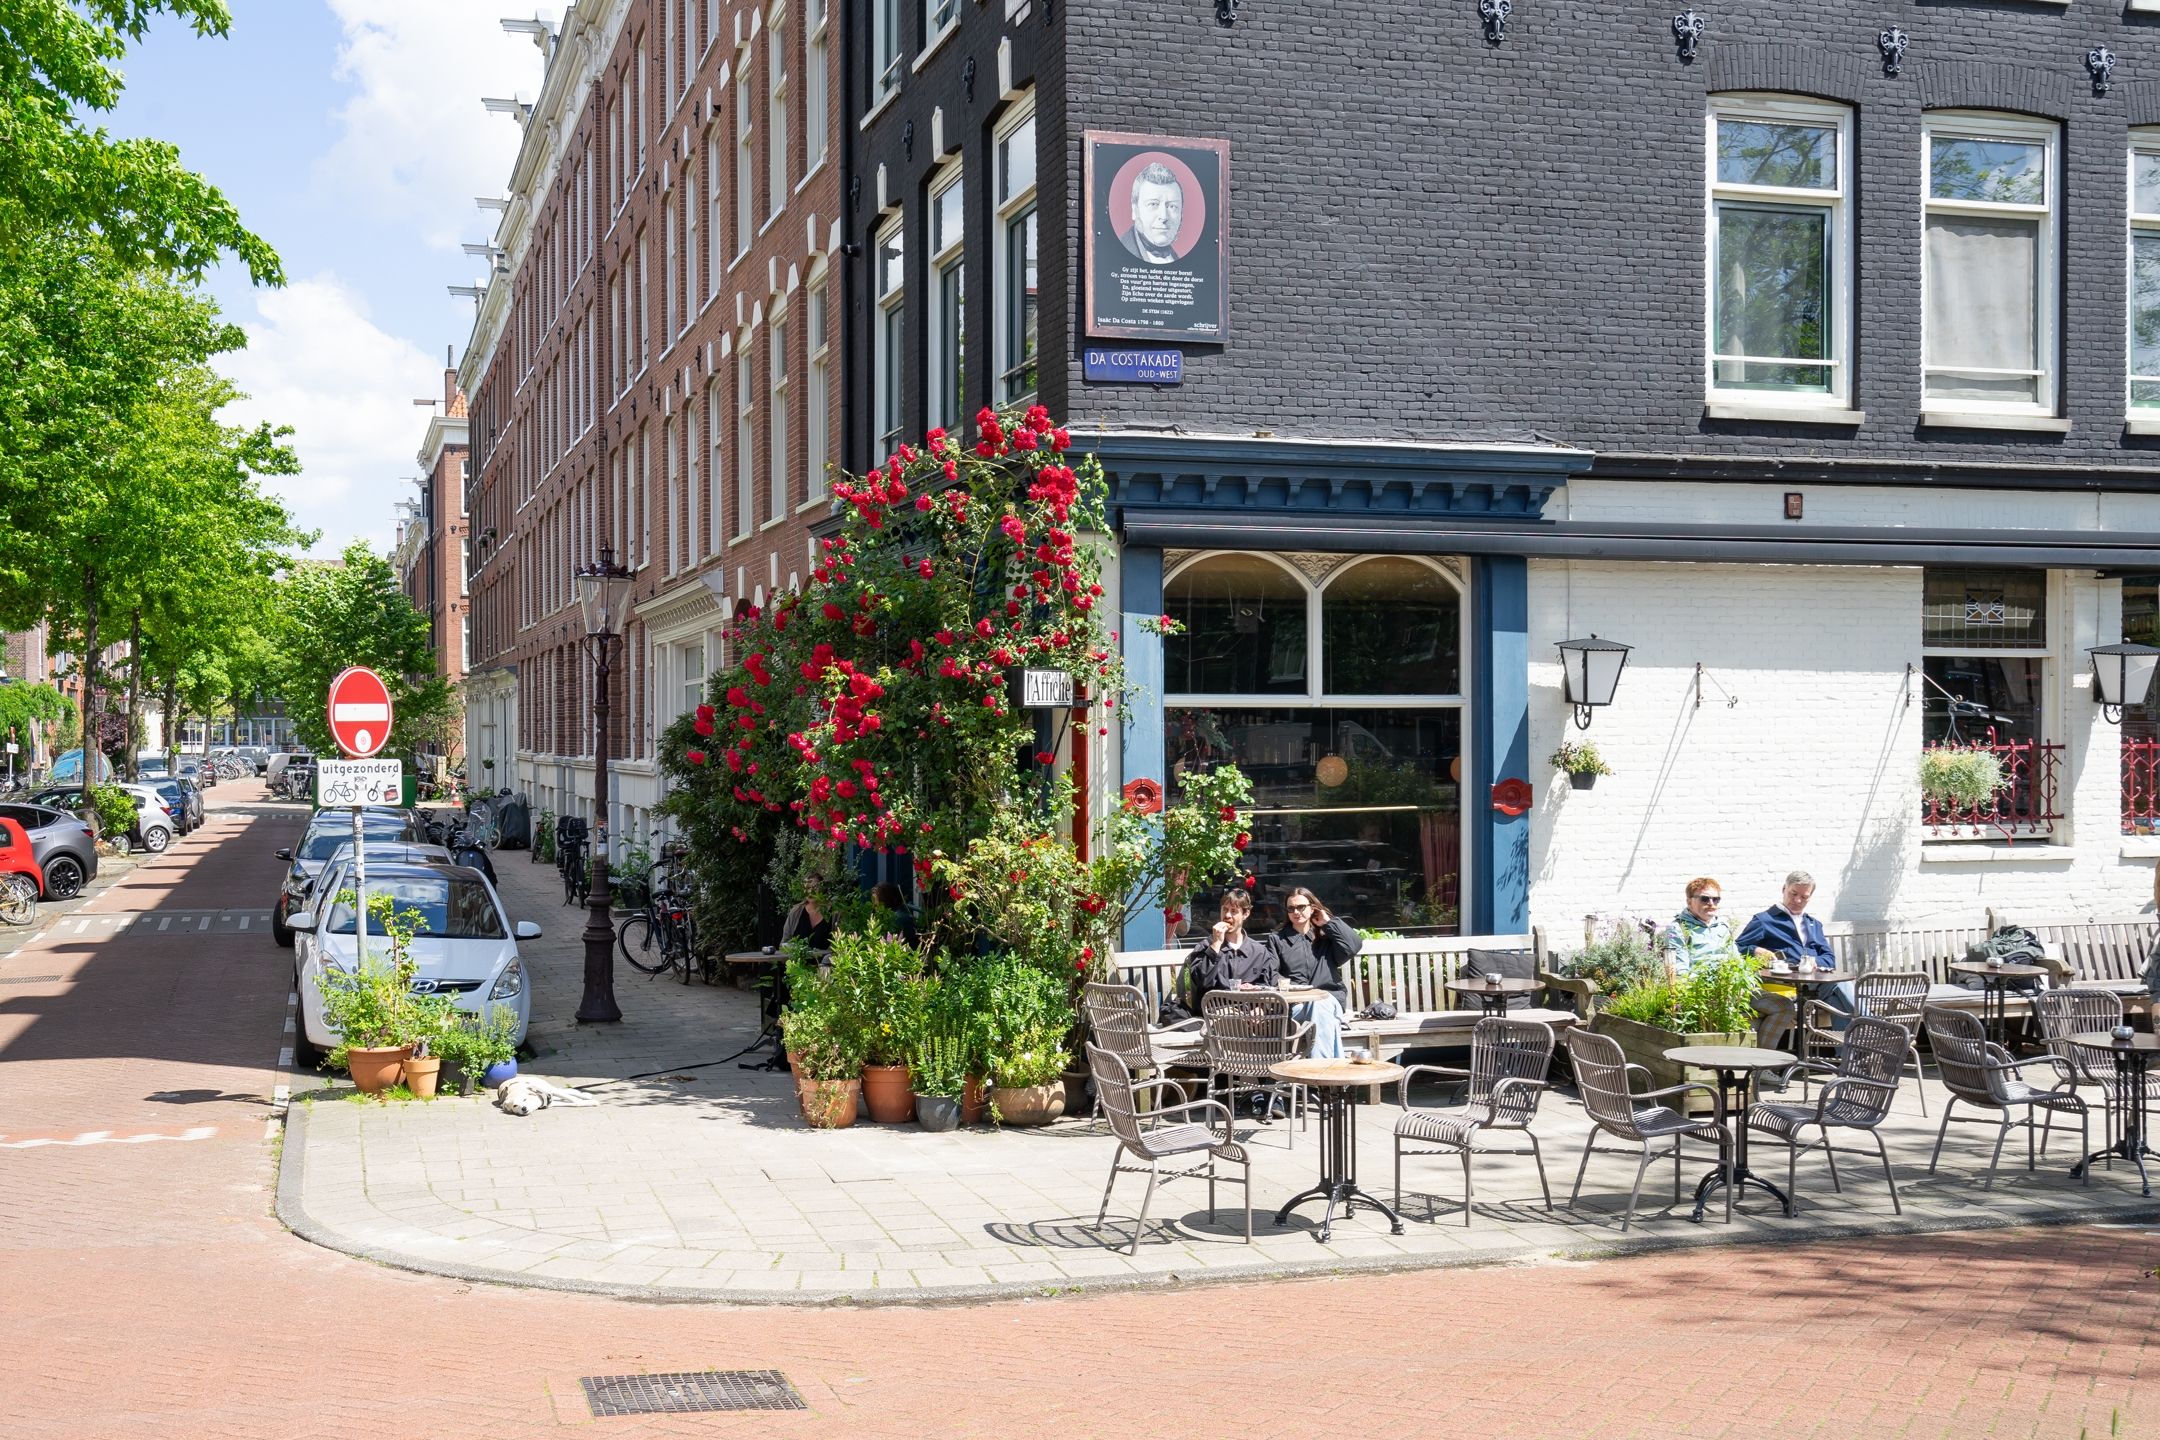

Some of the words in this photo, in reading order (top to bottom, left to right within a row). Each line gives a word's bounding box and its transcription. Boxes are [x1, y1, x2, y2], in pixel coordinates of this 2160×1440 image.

[1090, 352, 1106, 365] DA
[1111, 353, 1178, 367] COSTAKADE
[1138, 370, 1178, 378] OUD-WEST
[1026, 672, 1071, 702] l'Affiche
[322, 763, 399, 776] uitgezonderd
